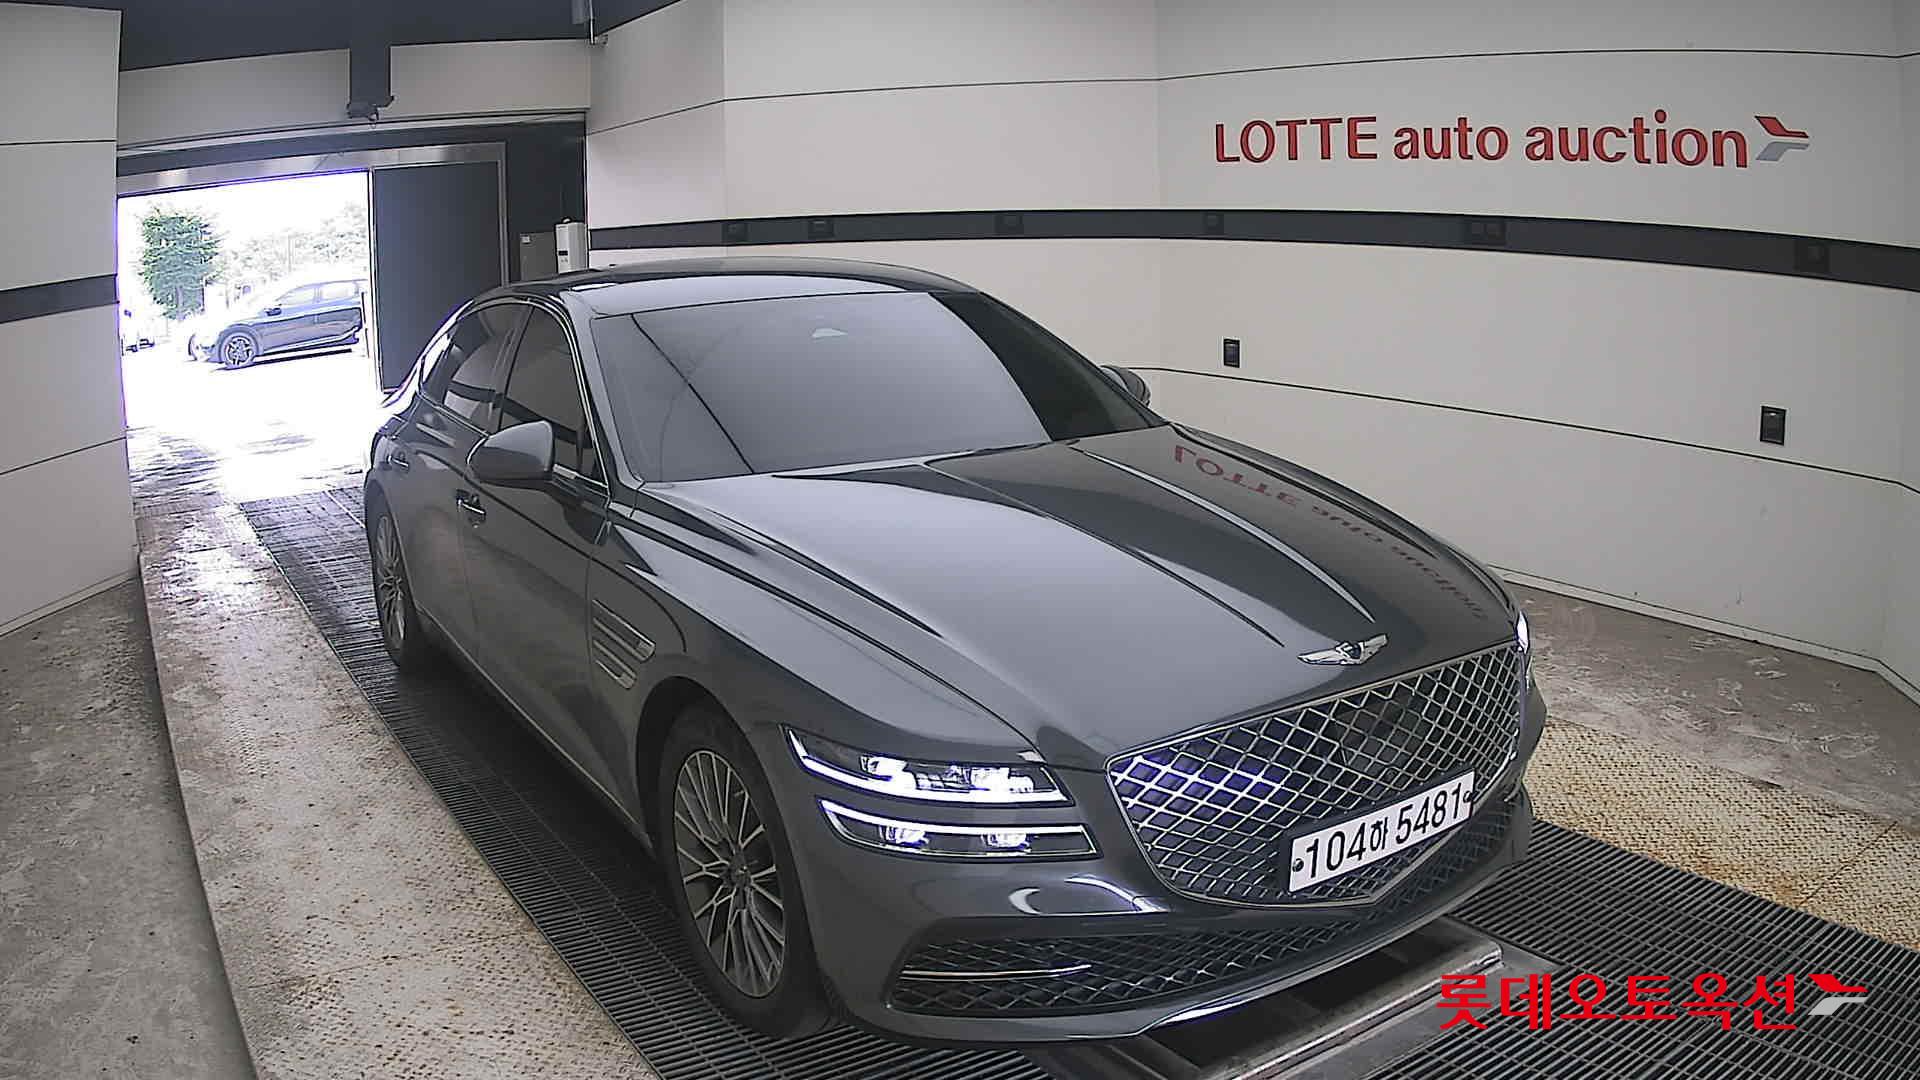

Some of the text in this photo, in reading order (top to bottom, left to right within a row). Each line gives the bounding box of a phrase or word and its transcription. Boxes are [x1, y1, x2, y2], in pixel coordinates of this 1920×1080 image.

[1215, 110, 1750, 169] LOTTE auto auction
[1306, 782, 1462, 878] 104하 5481
